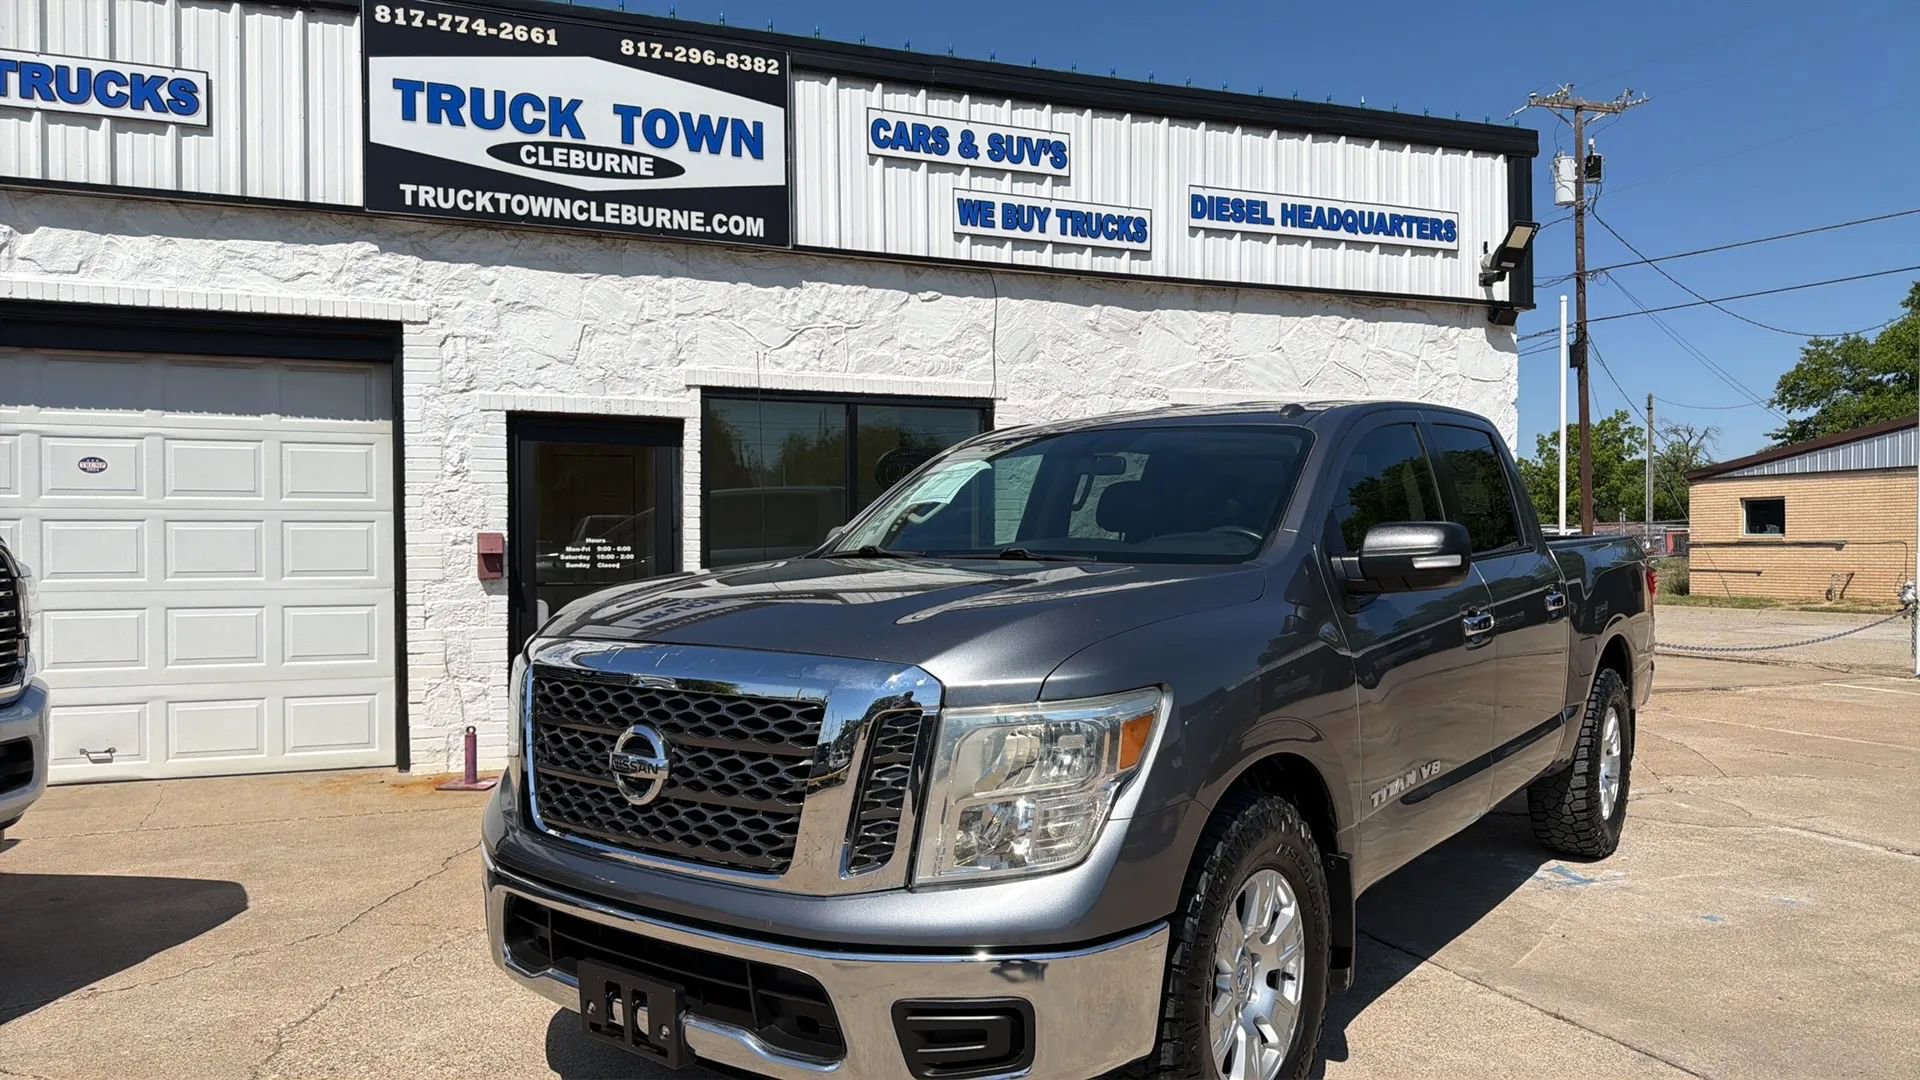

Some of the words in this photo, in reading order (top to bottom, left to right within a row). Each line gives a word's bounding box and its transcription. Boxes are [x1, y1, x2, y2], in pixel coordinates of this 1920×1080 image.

[374, 5, 559, 46] 817-774-2661
[620, 39, 780, 75] 817-296-8382
[0, 59, 200, 116] TRUCKS
[392, 78, 586, 140] TRUCK
[613, 103, 764, 161] TOWN
[871, 118, 950, 156] CARS
[958, 129, 980, 160] &
[987, 132, 1068, 170] SUV'S
[519, 144, 655, 177] CLEBURNE
[399, 183, 765, 238] TRUCKTOWNCLEBURNE.COM
[957, 198, 995, 229] WE
[1001, 203, 1051, 234] BUY
[1055, 208, 1149, 243] TRUCKS
[1190, 193, 1275, 226] DIESEL
[1281, 202, 1457, 243] HEADQUARTERS
[1369, 769, 1417, 808] TITAN
[1419, 759, 1441, 780] V8
